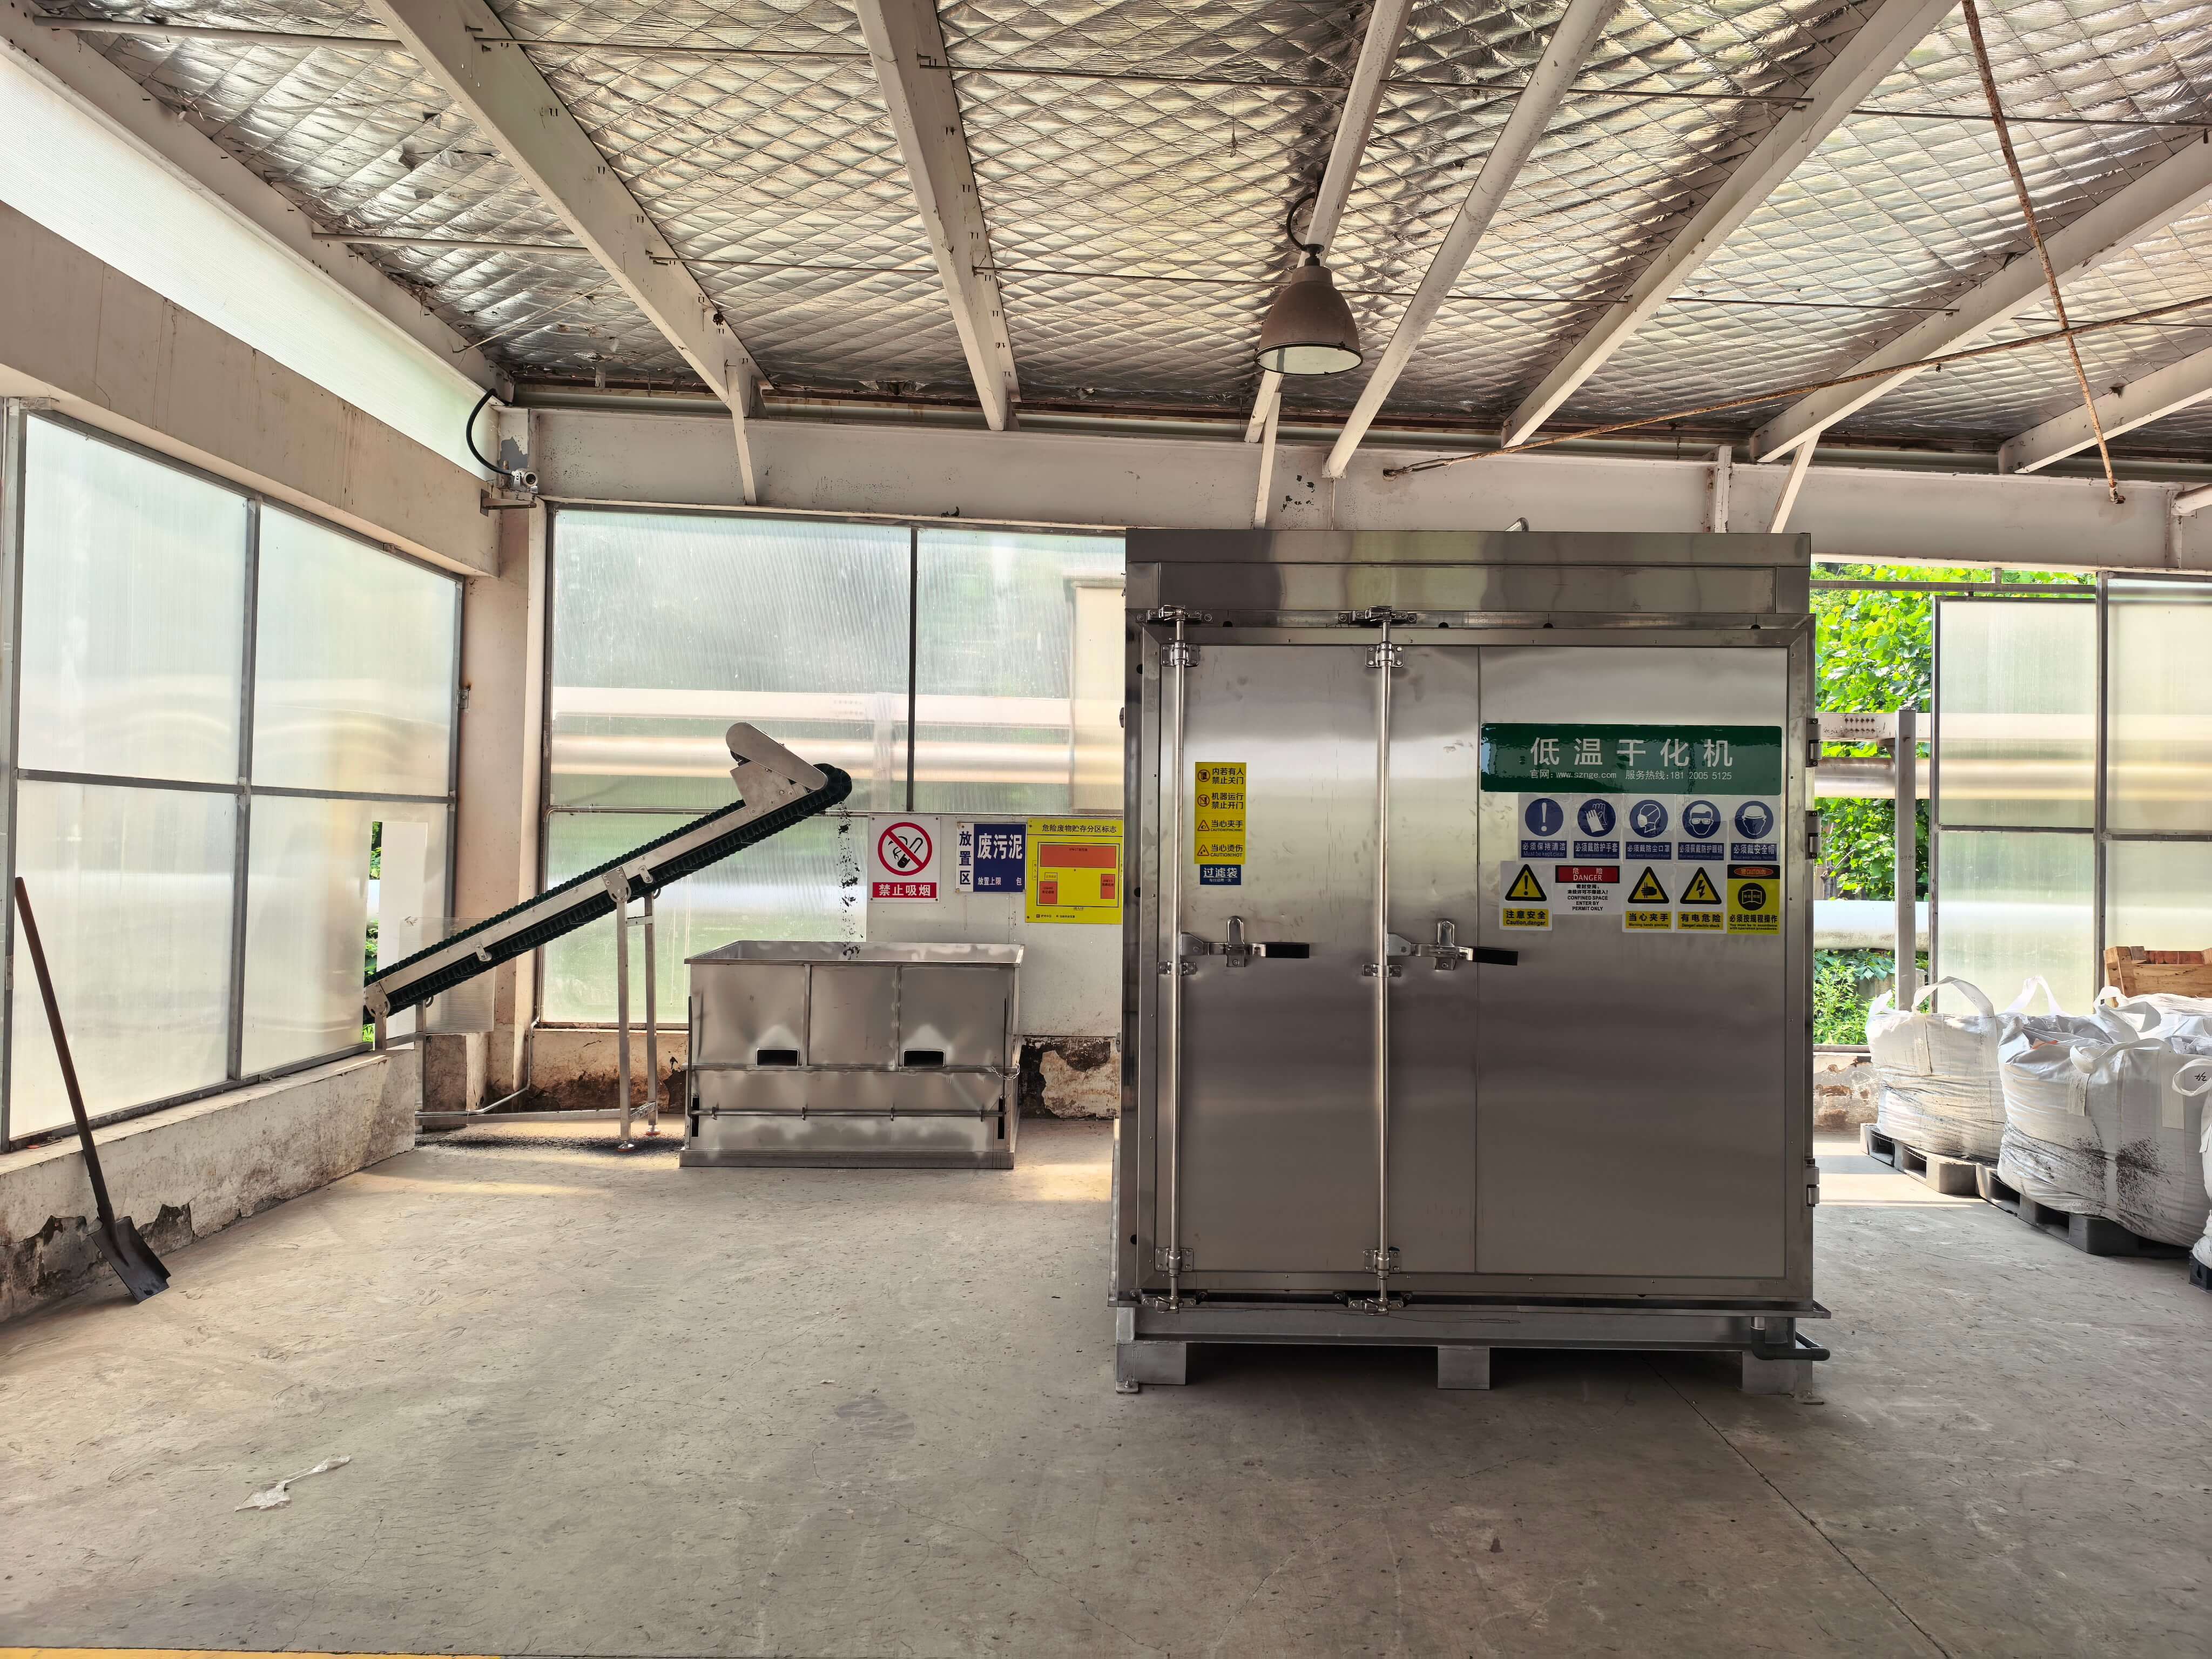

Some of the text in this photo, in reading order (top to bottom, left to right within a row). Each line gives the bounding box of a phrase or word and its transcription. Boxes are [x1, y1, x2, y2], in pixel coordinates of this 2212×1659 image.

[1530, 737, 1732, 767] 低温干化机
[1712, 772, 1732, 780] 5125
[1212, 777, 1244, 785] 禁止关门
[1211, 801, 1243, 810] 禁止开门
[1042, 824, 1117, 833] 危险废物贮存分区标志
[977, 833, 1023, 860] 废污泥
[1211, 844, 1243, 852] 当心烫伤
[1522, 842, 1566, 851] 必须保持清洁
[1575, 842, 1618, 852] 必须戴防护手套
[1627, 844, 1670, 853] 必须戴防尘口罩
[1734, 845, 1775, 854] 必须戴安全帽
[959, 831, 972, 885] 放置区
[1203, 867, 1238, 878] 过滤袋
[977, 876, 1022, 886] 放置上限 包
[879, 884, 930, 896] 禁止吸烟
[1506, 911, 1546, 919] 注意安全
[1629, 913, 1668, 922] 当心夹手
[1681, 913, 1721, 923] 有电危险
[1729, 914, 1778, 923] 必须按规程操作
